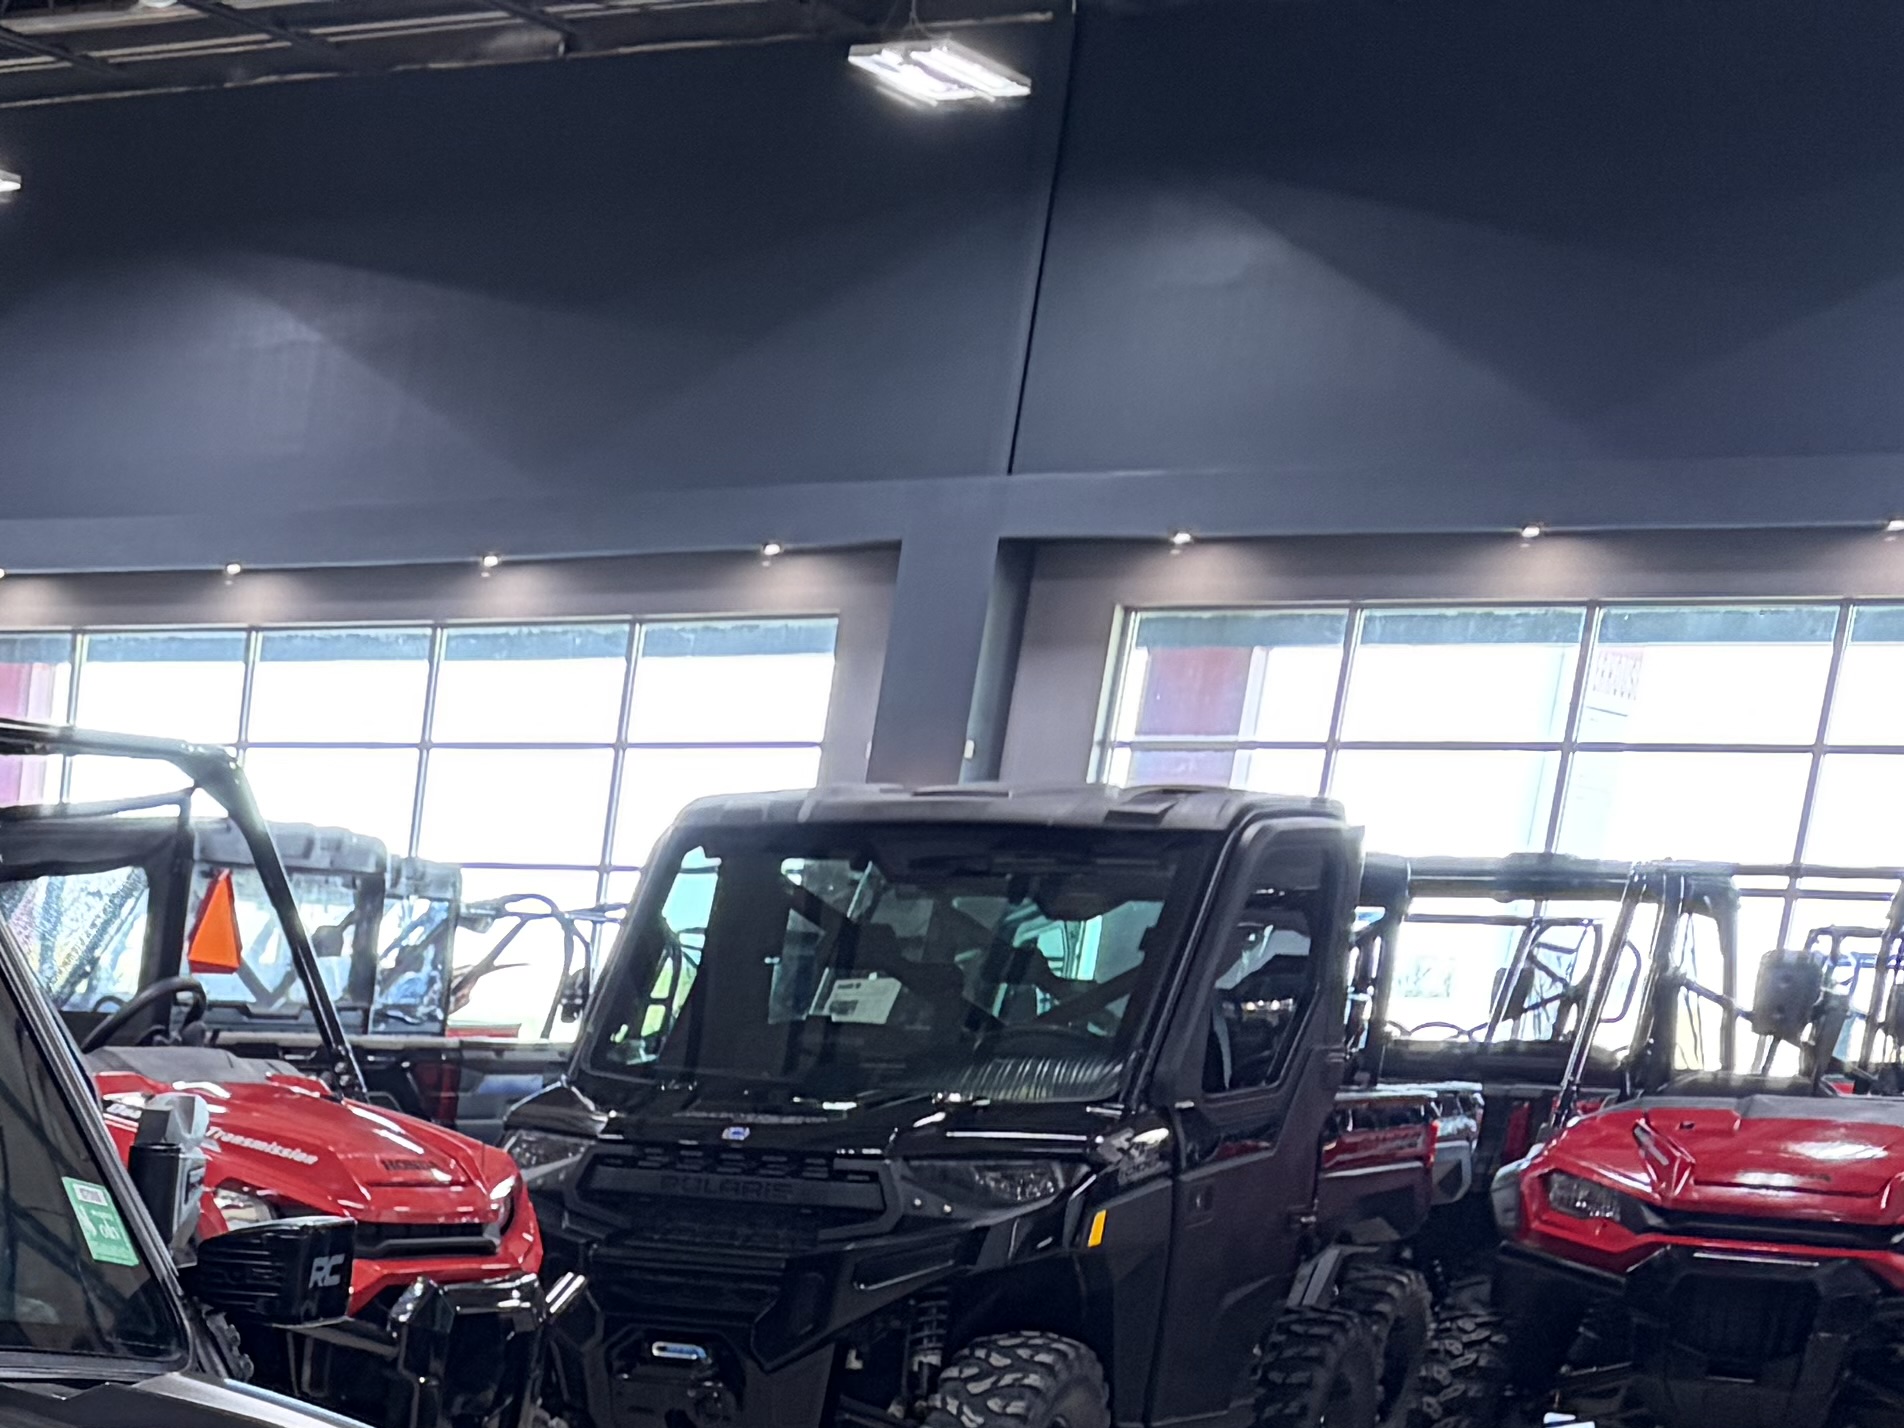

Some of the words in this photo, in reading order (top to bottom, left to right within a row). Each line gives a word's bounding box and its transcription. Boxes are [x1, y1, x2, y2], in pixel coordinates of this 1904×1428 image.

[205, 1126, 319, 1166] Transmission
[379, 1158, 438, 1172] HONDA
[659, 1174, 794, 1199] POLARIS
[308, 1253, 345, 1288] RC
